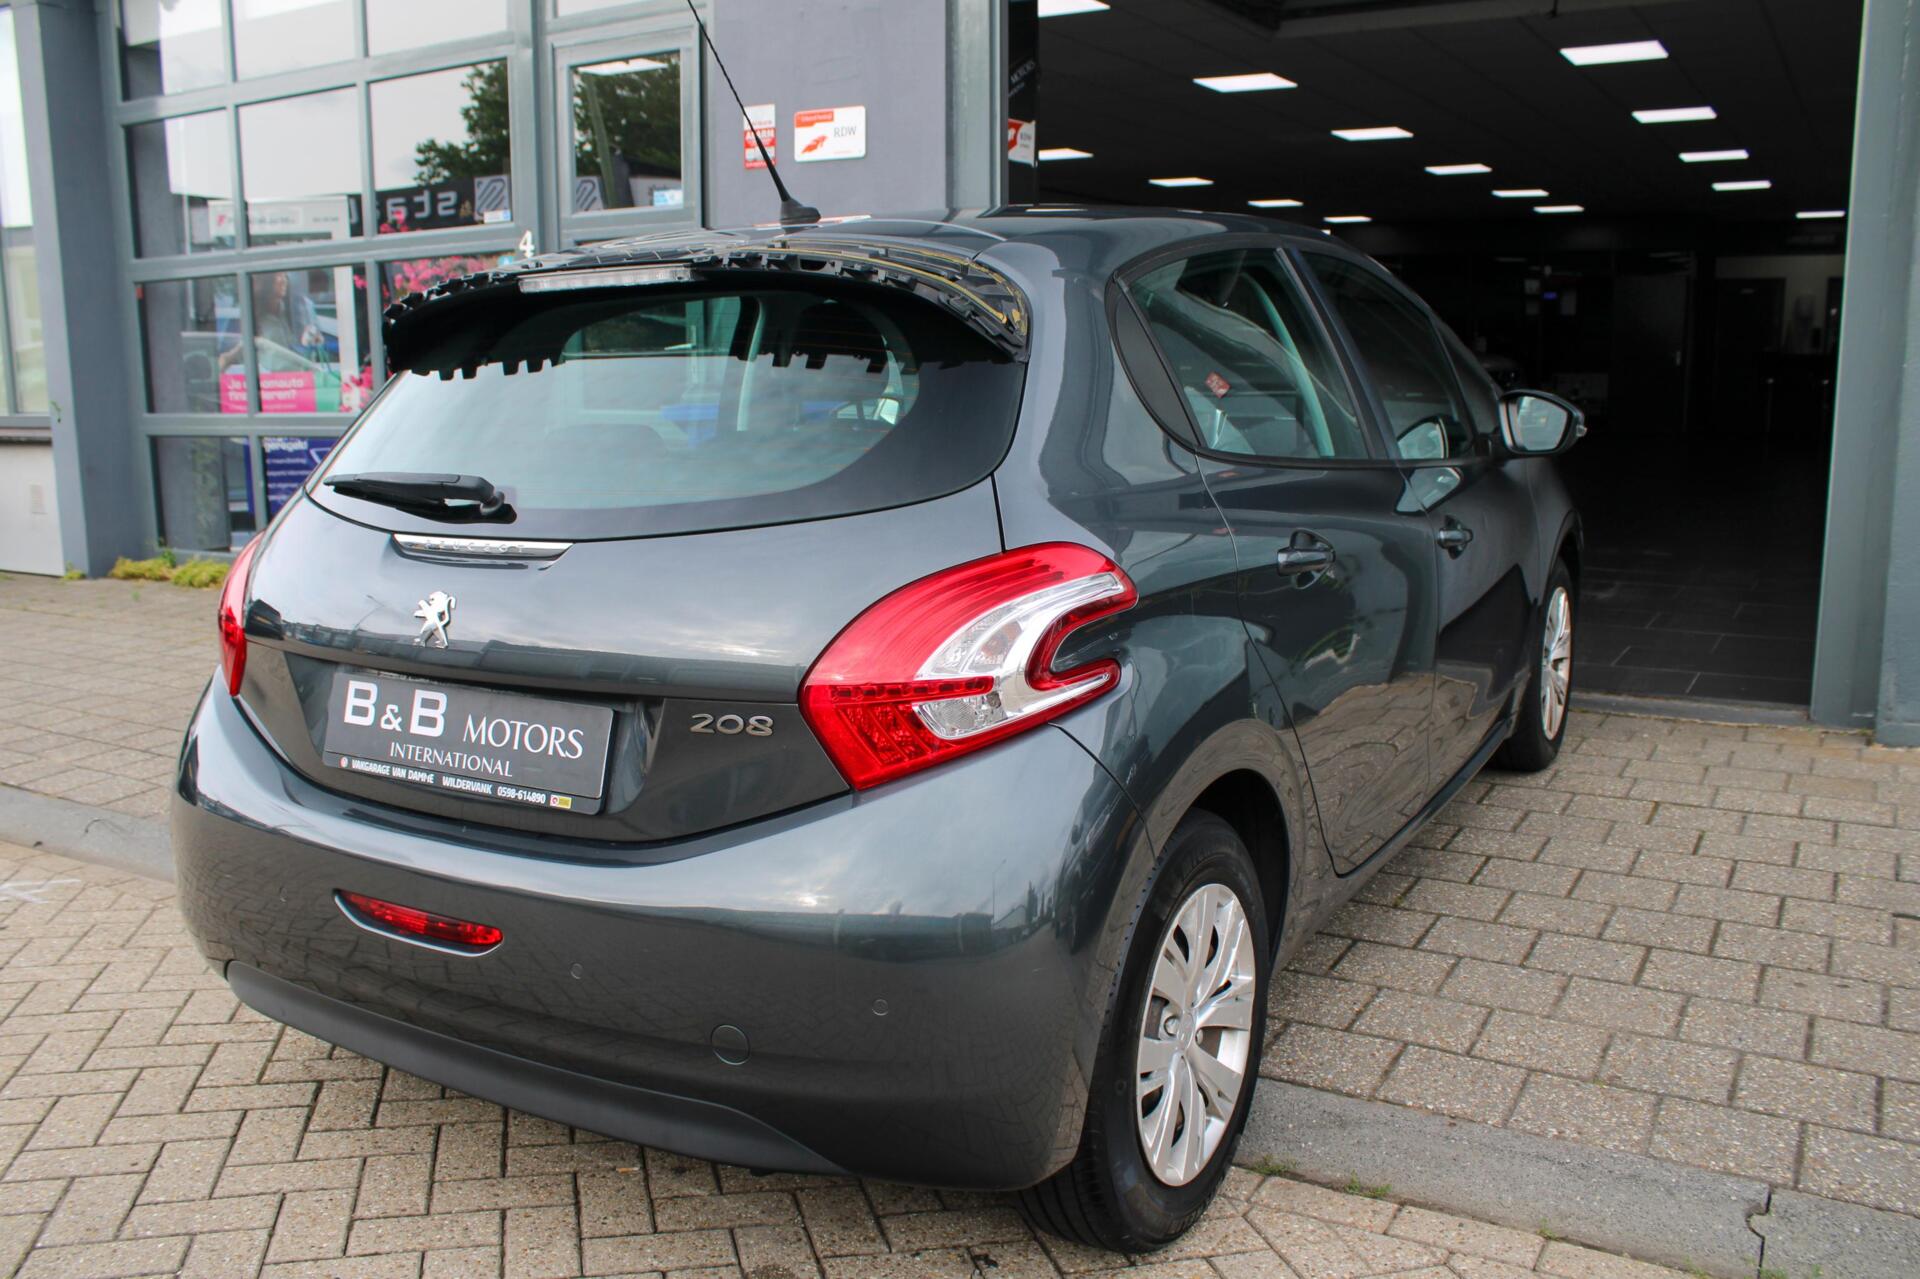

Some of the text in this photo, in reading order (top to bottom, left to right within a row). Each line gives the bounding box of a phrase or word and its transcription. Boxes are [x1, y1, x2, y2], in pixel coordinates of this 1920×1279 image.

[833, 126, 857, 137] RDW
[519, 230, 535, 258] 4
[462, 713, 584, 759] MOTORS
[690, 713, 774, 737] 208
[390, 741, 513, 777] INTERNATIONAL
[392, 766, 407, 780] VAN
[442, 775, 493, 796] WILDERVANK
[497, 785, 546, 804] 0598-614890
